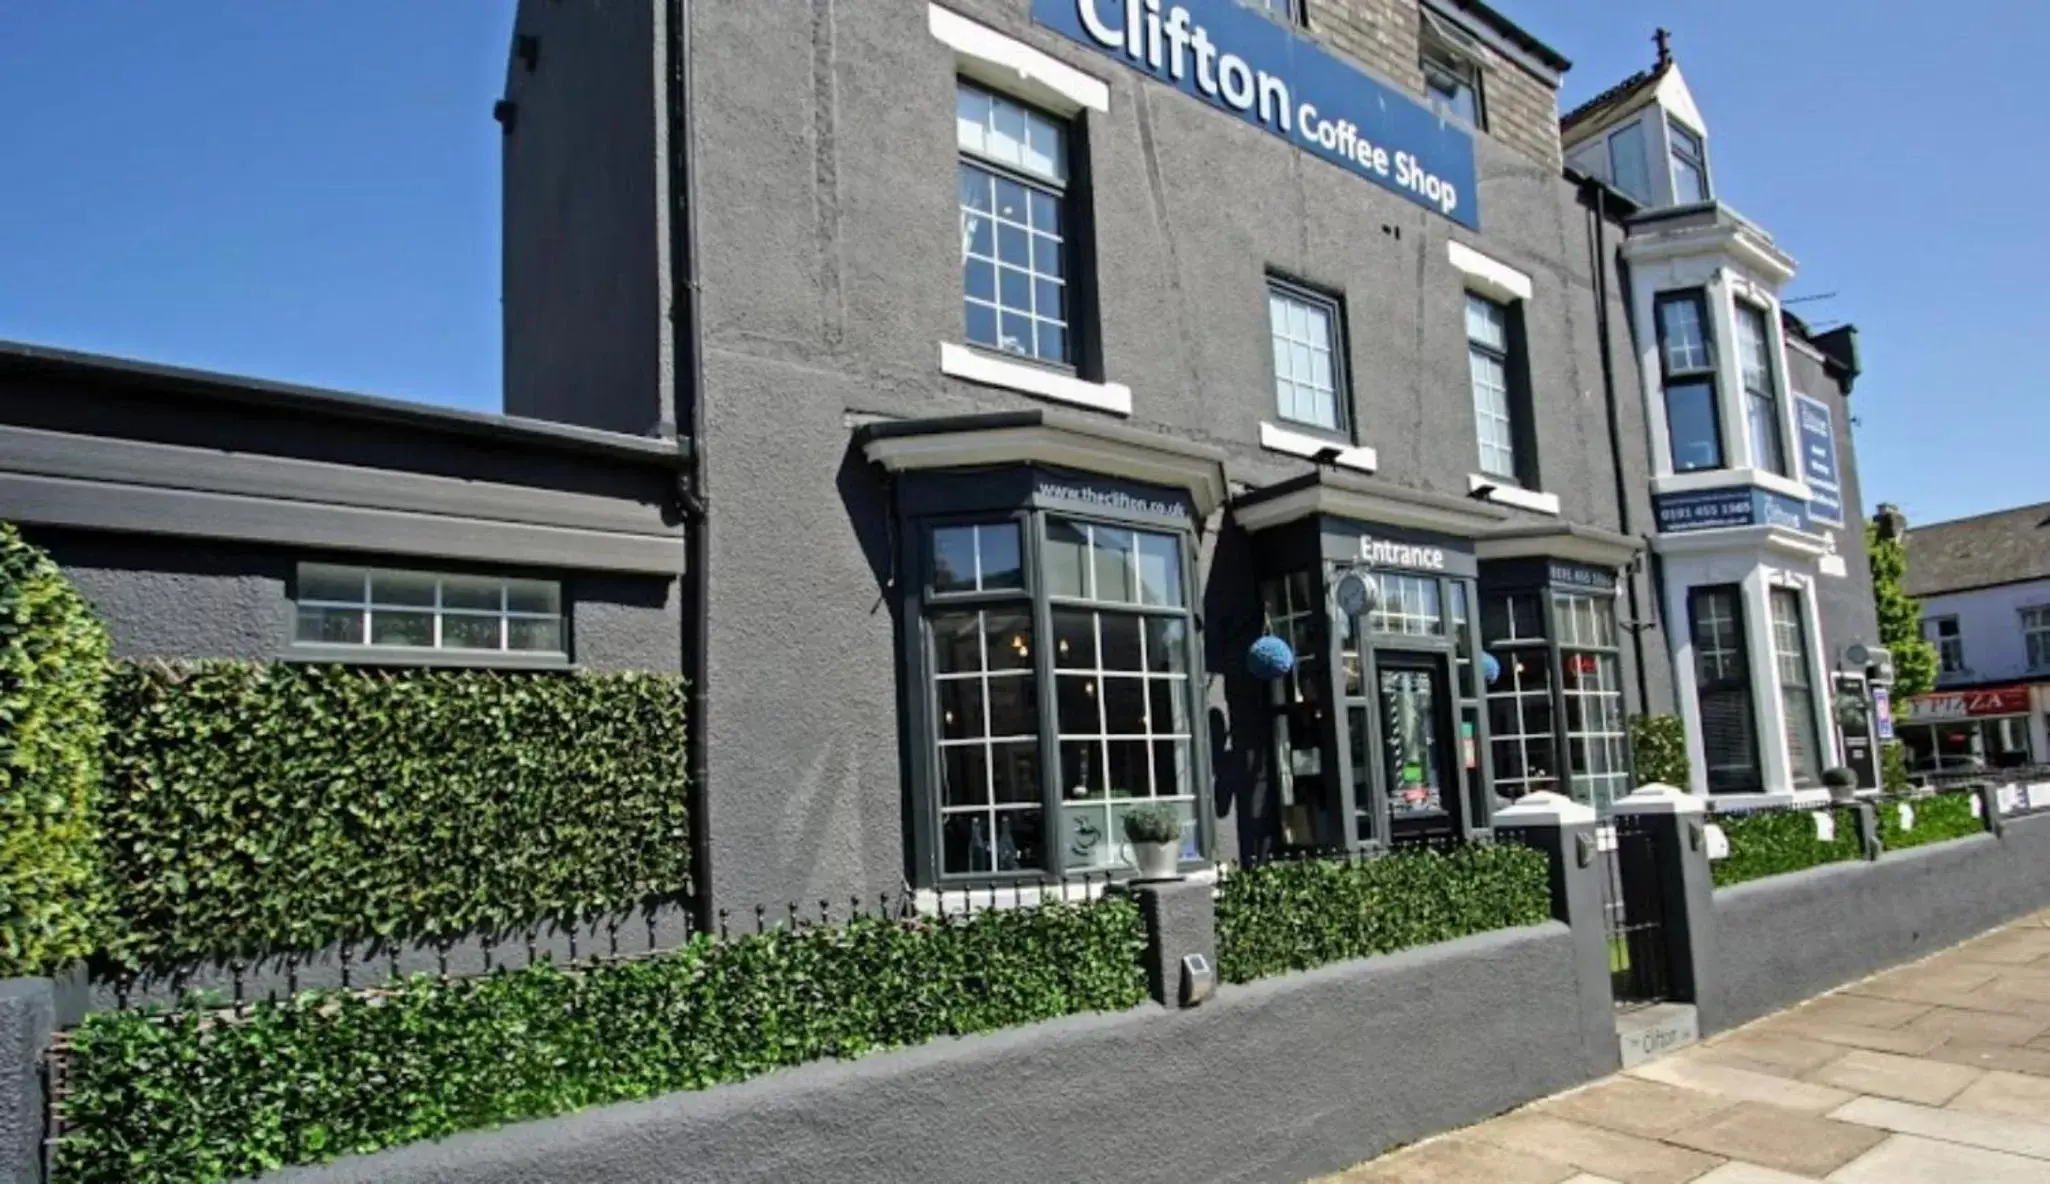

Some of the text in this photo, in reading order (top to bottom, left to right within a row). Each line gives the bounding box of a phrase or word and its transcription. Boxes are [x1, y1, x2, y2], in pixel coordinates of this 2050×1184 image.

[1076, 0, 1458, 213] Clifton Coffee Shop
[1360, 534, 1445, 569] Entrance
